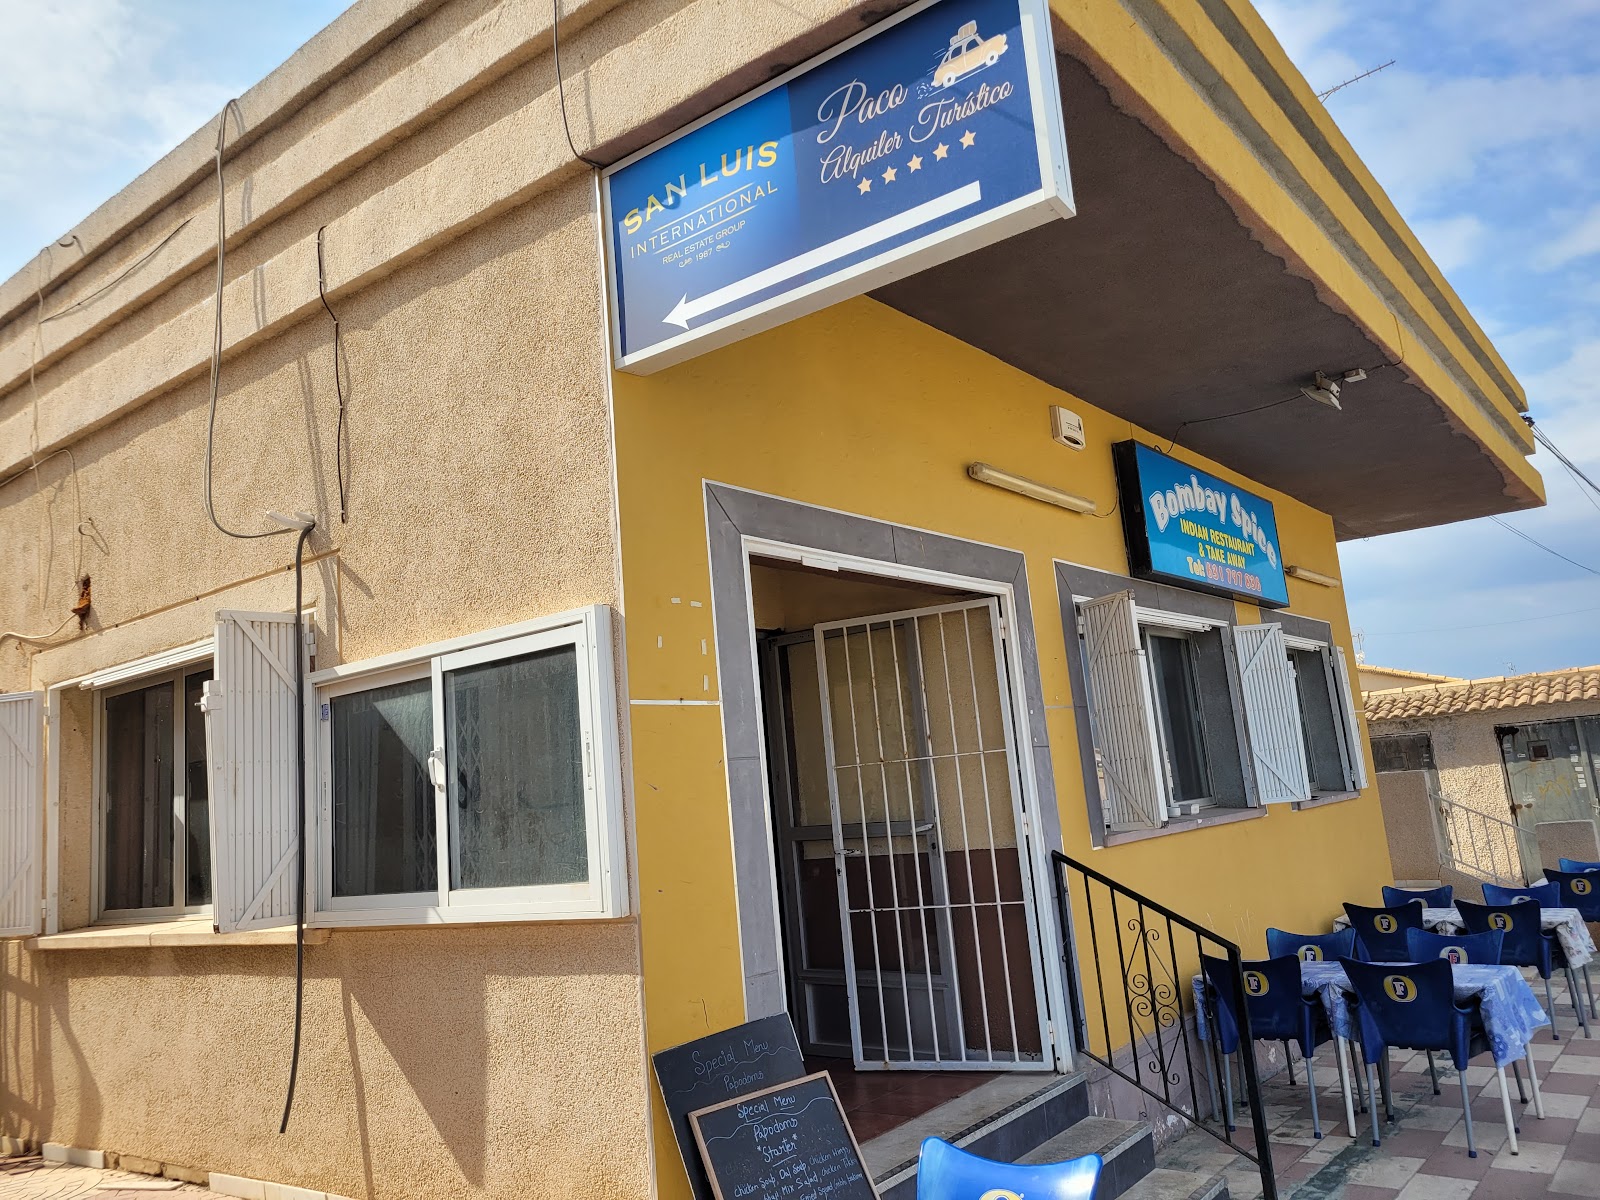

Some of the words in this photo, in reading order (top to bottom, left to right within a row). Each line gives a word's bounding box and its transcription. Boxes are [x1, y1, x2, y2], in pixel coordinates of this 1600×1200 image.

[817, 78, 909, 144] Paco
[820, 130, 903, 184] Alquiler
[909, 81, 1014, 143] Turístico
[623, 174, 688, 235] SAN
[699, 141, 778, 187] LUIS
[630, 180, 778, 259] INTERNATIONAL
[662, 250, 683, 265] REAL
[684, 235, 714, 255] ESTATE
[715, 220, 746, 240] GROUP
[695, 249, 713, 262] 1987
[1149, 474, 1227, 533] Bombay
[1231, 493, 1277, 569] Spice
[1180, 518, 1209, 541] INDIAN
[1210, 529, 1255, 557] RESTAURANT
[1198, 542, 1205, 558] &
[1205, 544, 1226, 564] TAKE
[1227, 551, 1246, 569] AWAY
[1206, 562, 1224, 582] 631
[1226, 567, 1243, 587] 797
[691, 1046, 738, 1080] Special
[743, 1039, 769, 1057] Menu
[736, 1100, 769, 1122] Special
[774, 1095, 796, 1106] Menu
[734, 1181, 760, 1198] Chicken
[781, 1184, 795, 1197] Mix
